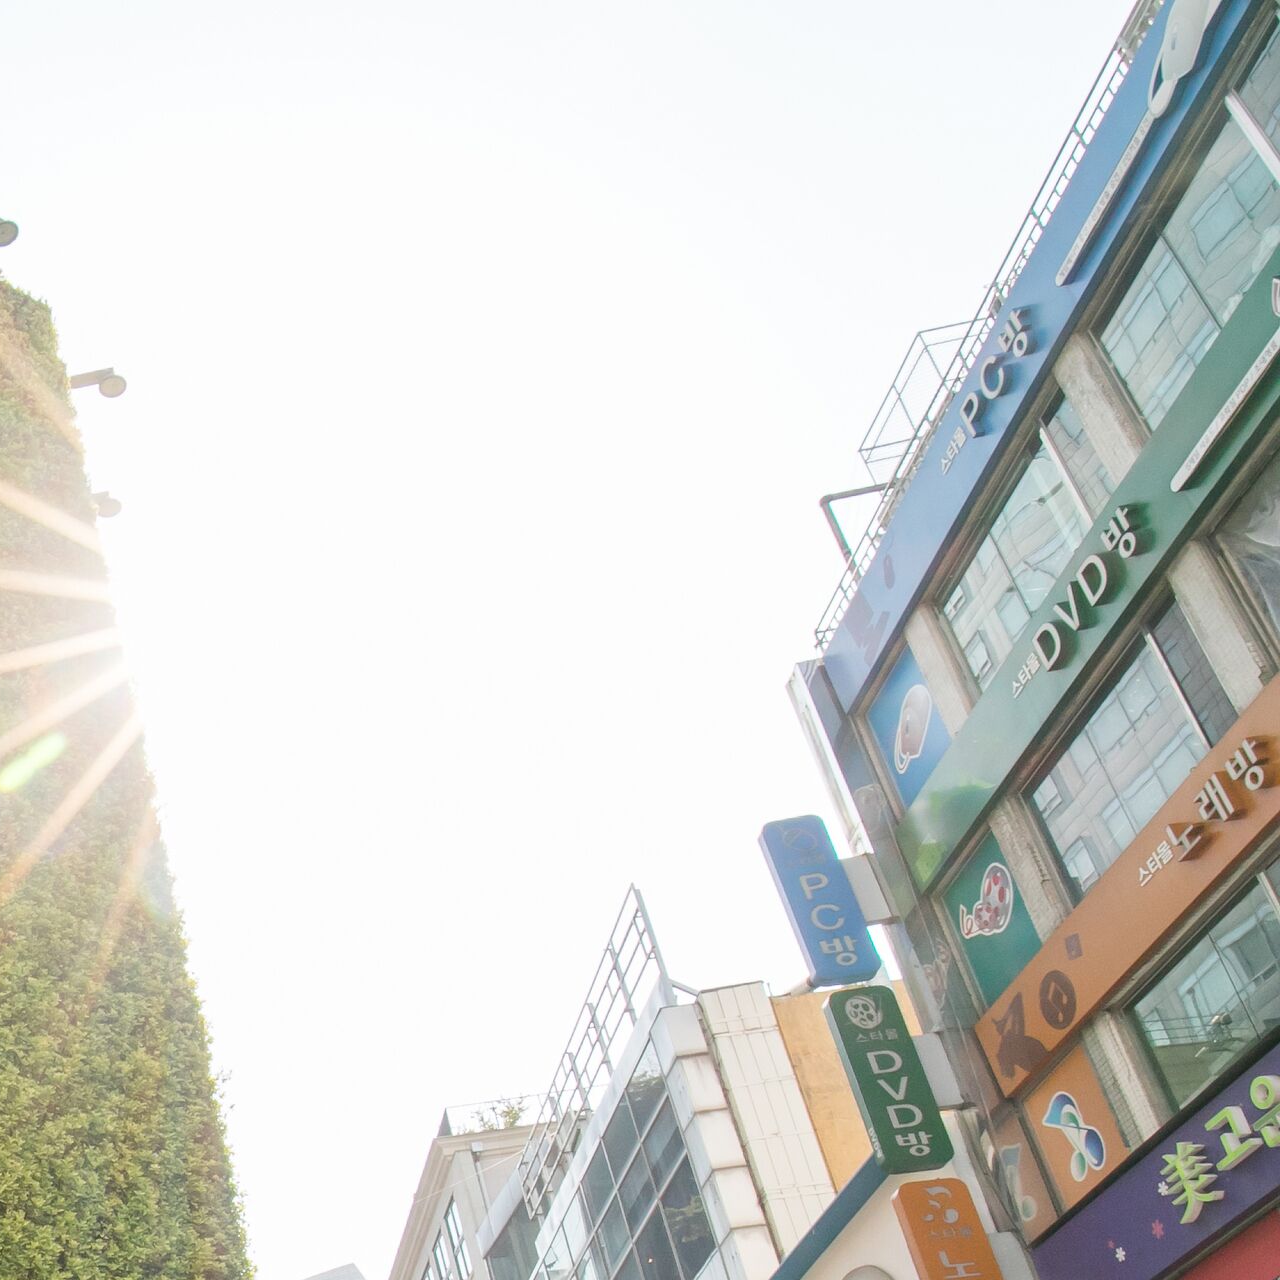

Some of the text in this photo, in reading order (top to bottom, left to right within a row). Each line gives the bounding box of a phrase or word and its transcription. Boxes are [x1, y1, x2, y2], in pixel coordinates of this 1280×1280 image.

[959, 308, 1030, 439] PC방
[1032, 506, 1137, 672] DVD방
[1165, 738, 1265, 862] 노래방
[799, 872, 859, 966] PC방
[866, 1050, 933, 1158] DVD방
